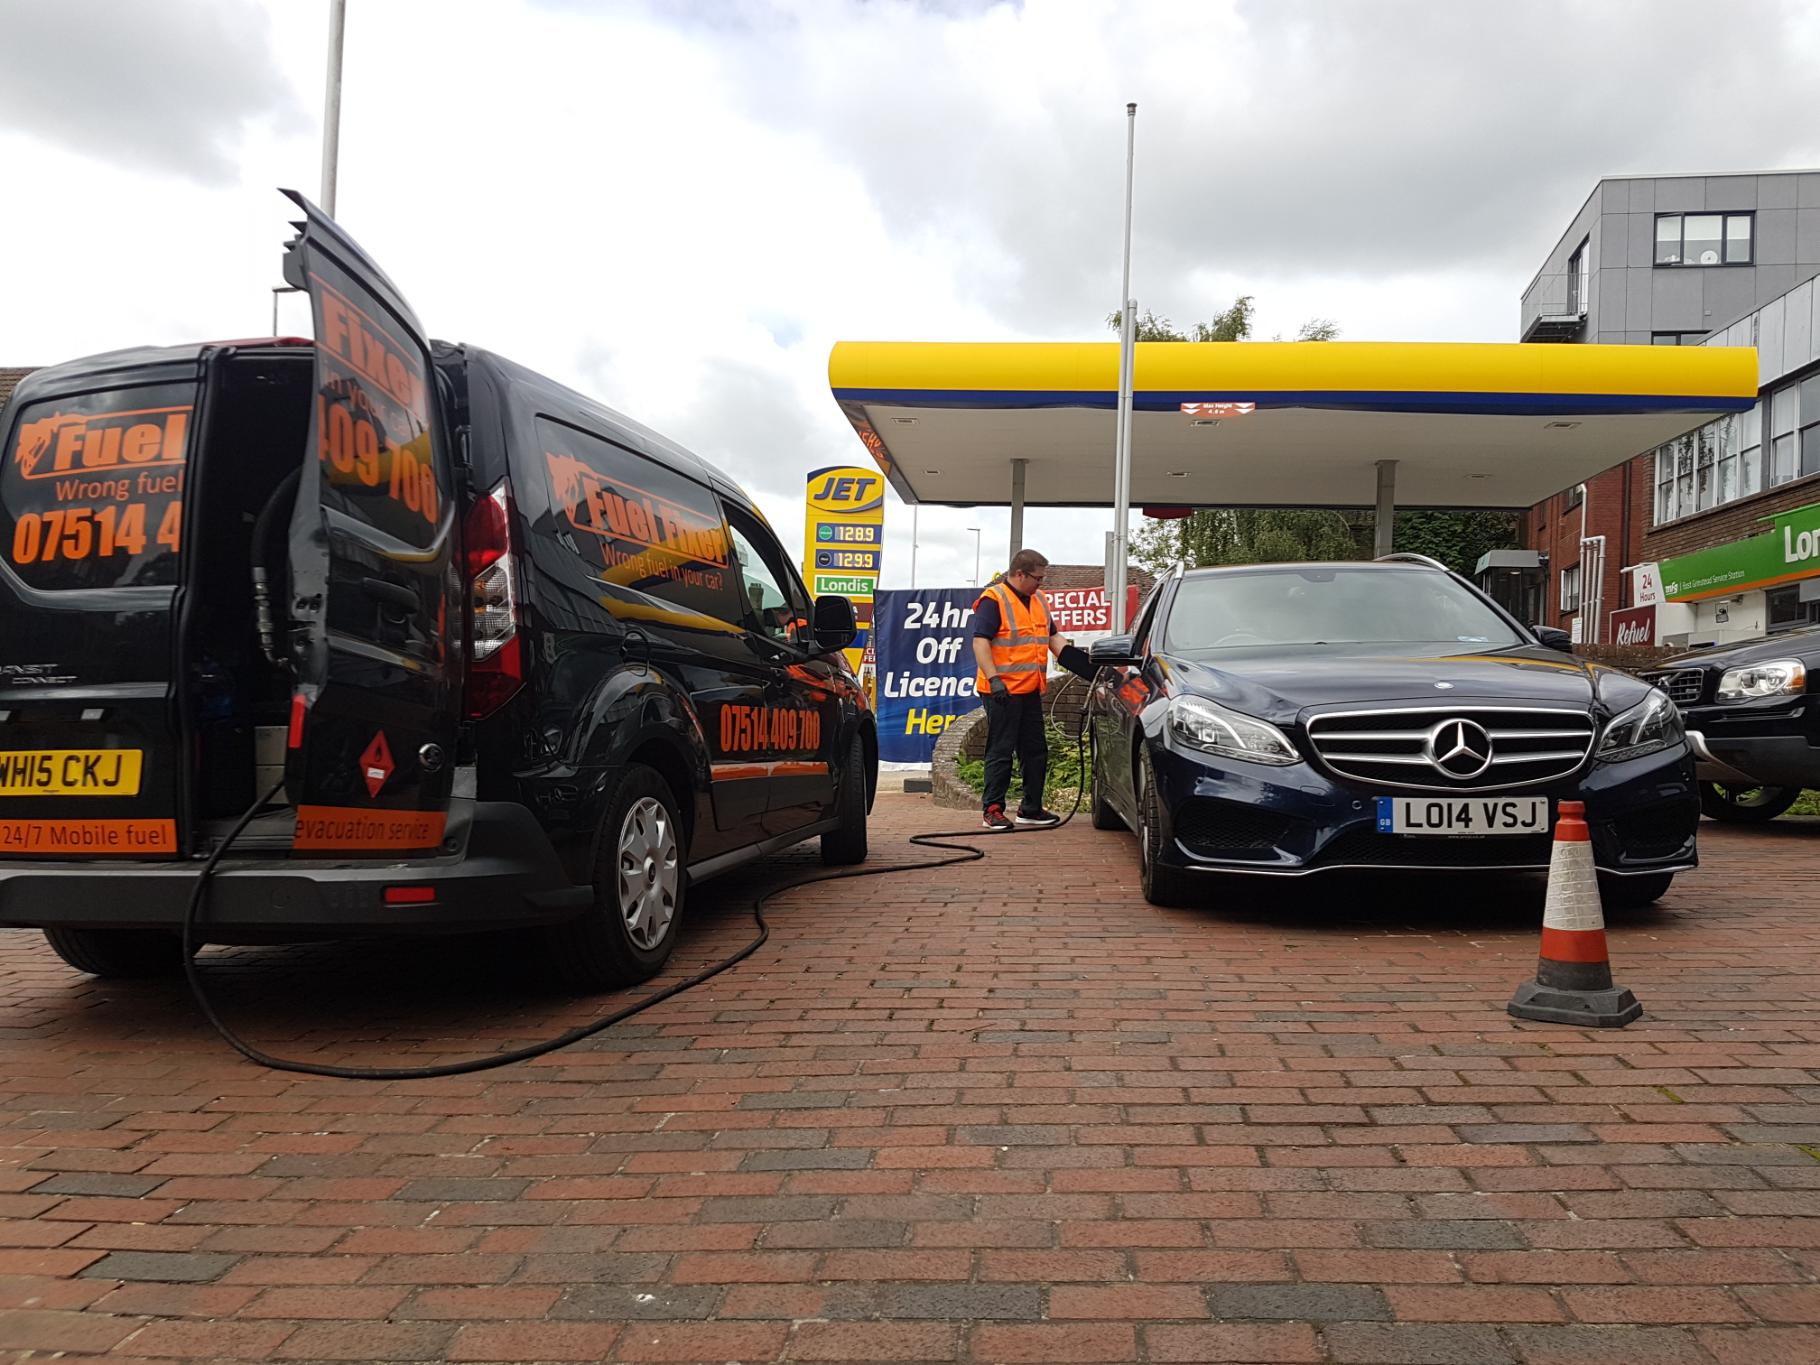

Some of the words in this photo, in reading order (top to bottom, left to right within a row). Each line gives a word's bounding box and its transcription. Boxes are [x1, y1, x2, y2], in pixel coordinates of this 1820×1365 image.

[322, 290, 426, 412] Fixer
[54, 414, 187, 470] Fuel
[56, 479, 130, 501] Wrong
[138, 469, 184, 494] fuel
[385, 435, 437, 524] 700
[813, 476, 877, 501] JET
[582, 476, 660, 545] Fuel
[660, 504, 724, 563] Fixer
[13, 503, 146, 564] 07514
[601, 543, 645, 579] Wrong
[646, 549, 668, 580] fuel
[671, 561, 680, 584] in
[683, 567, 702, 589] your
[705, 573, 723, 591] car?
[821, 577, 869, 592] Londis
[1642, 574, 1652, 589] 24
[1045, 590, 1111, 609] PECIAL
[1640, 592, 1656, 602] Hours
[904, 602, 974, 630] 24hr
[1050, 609, 1107, 626] FFERS
[1616, 618, 1650, 646] Refuel
[916, 637, 964, 664] Off
[884, 671, 980, 698] Licenc
[720, 703, 768, 752] 07514
[771, 707, 797, 751] 409
[799, 709, 821, 750] 700
[905, 708, 964, 735] Her
[62, 755, 122, 788] CKJ
[295, 816, 385, 840] evacuation
[389, 818, 430, 840] service
[1379, 818, 1391, 826] GB
[1405, 802, 1473, 829] LO14
[1483, 802, 1537, 829] VSJ
[3, 824, 42, 848] 24/7
[51, 825, 118, 846] Mobile
[127, 824, 166, 845] fuel
